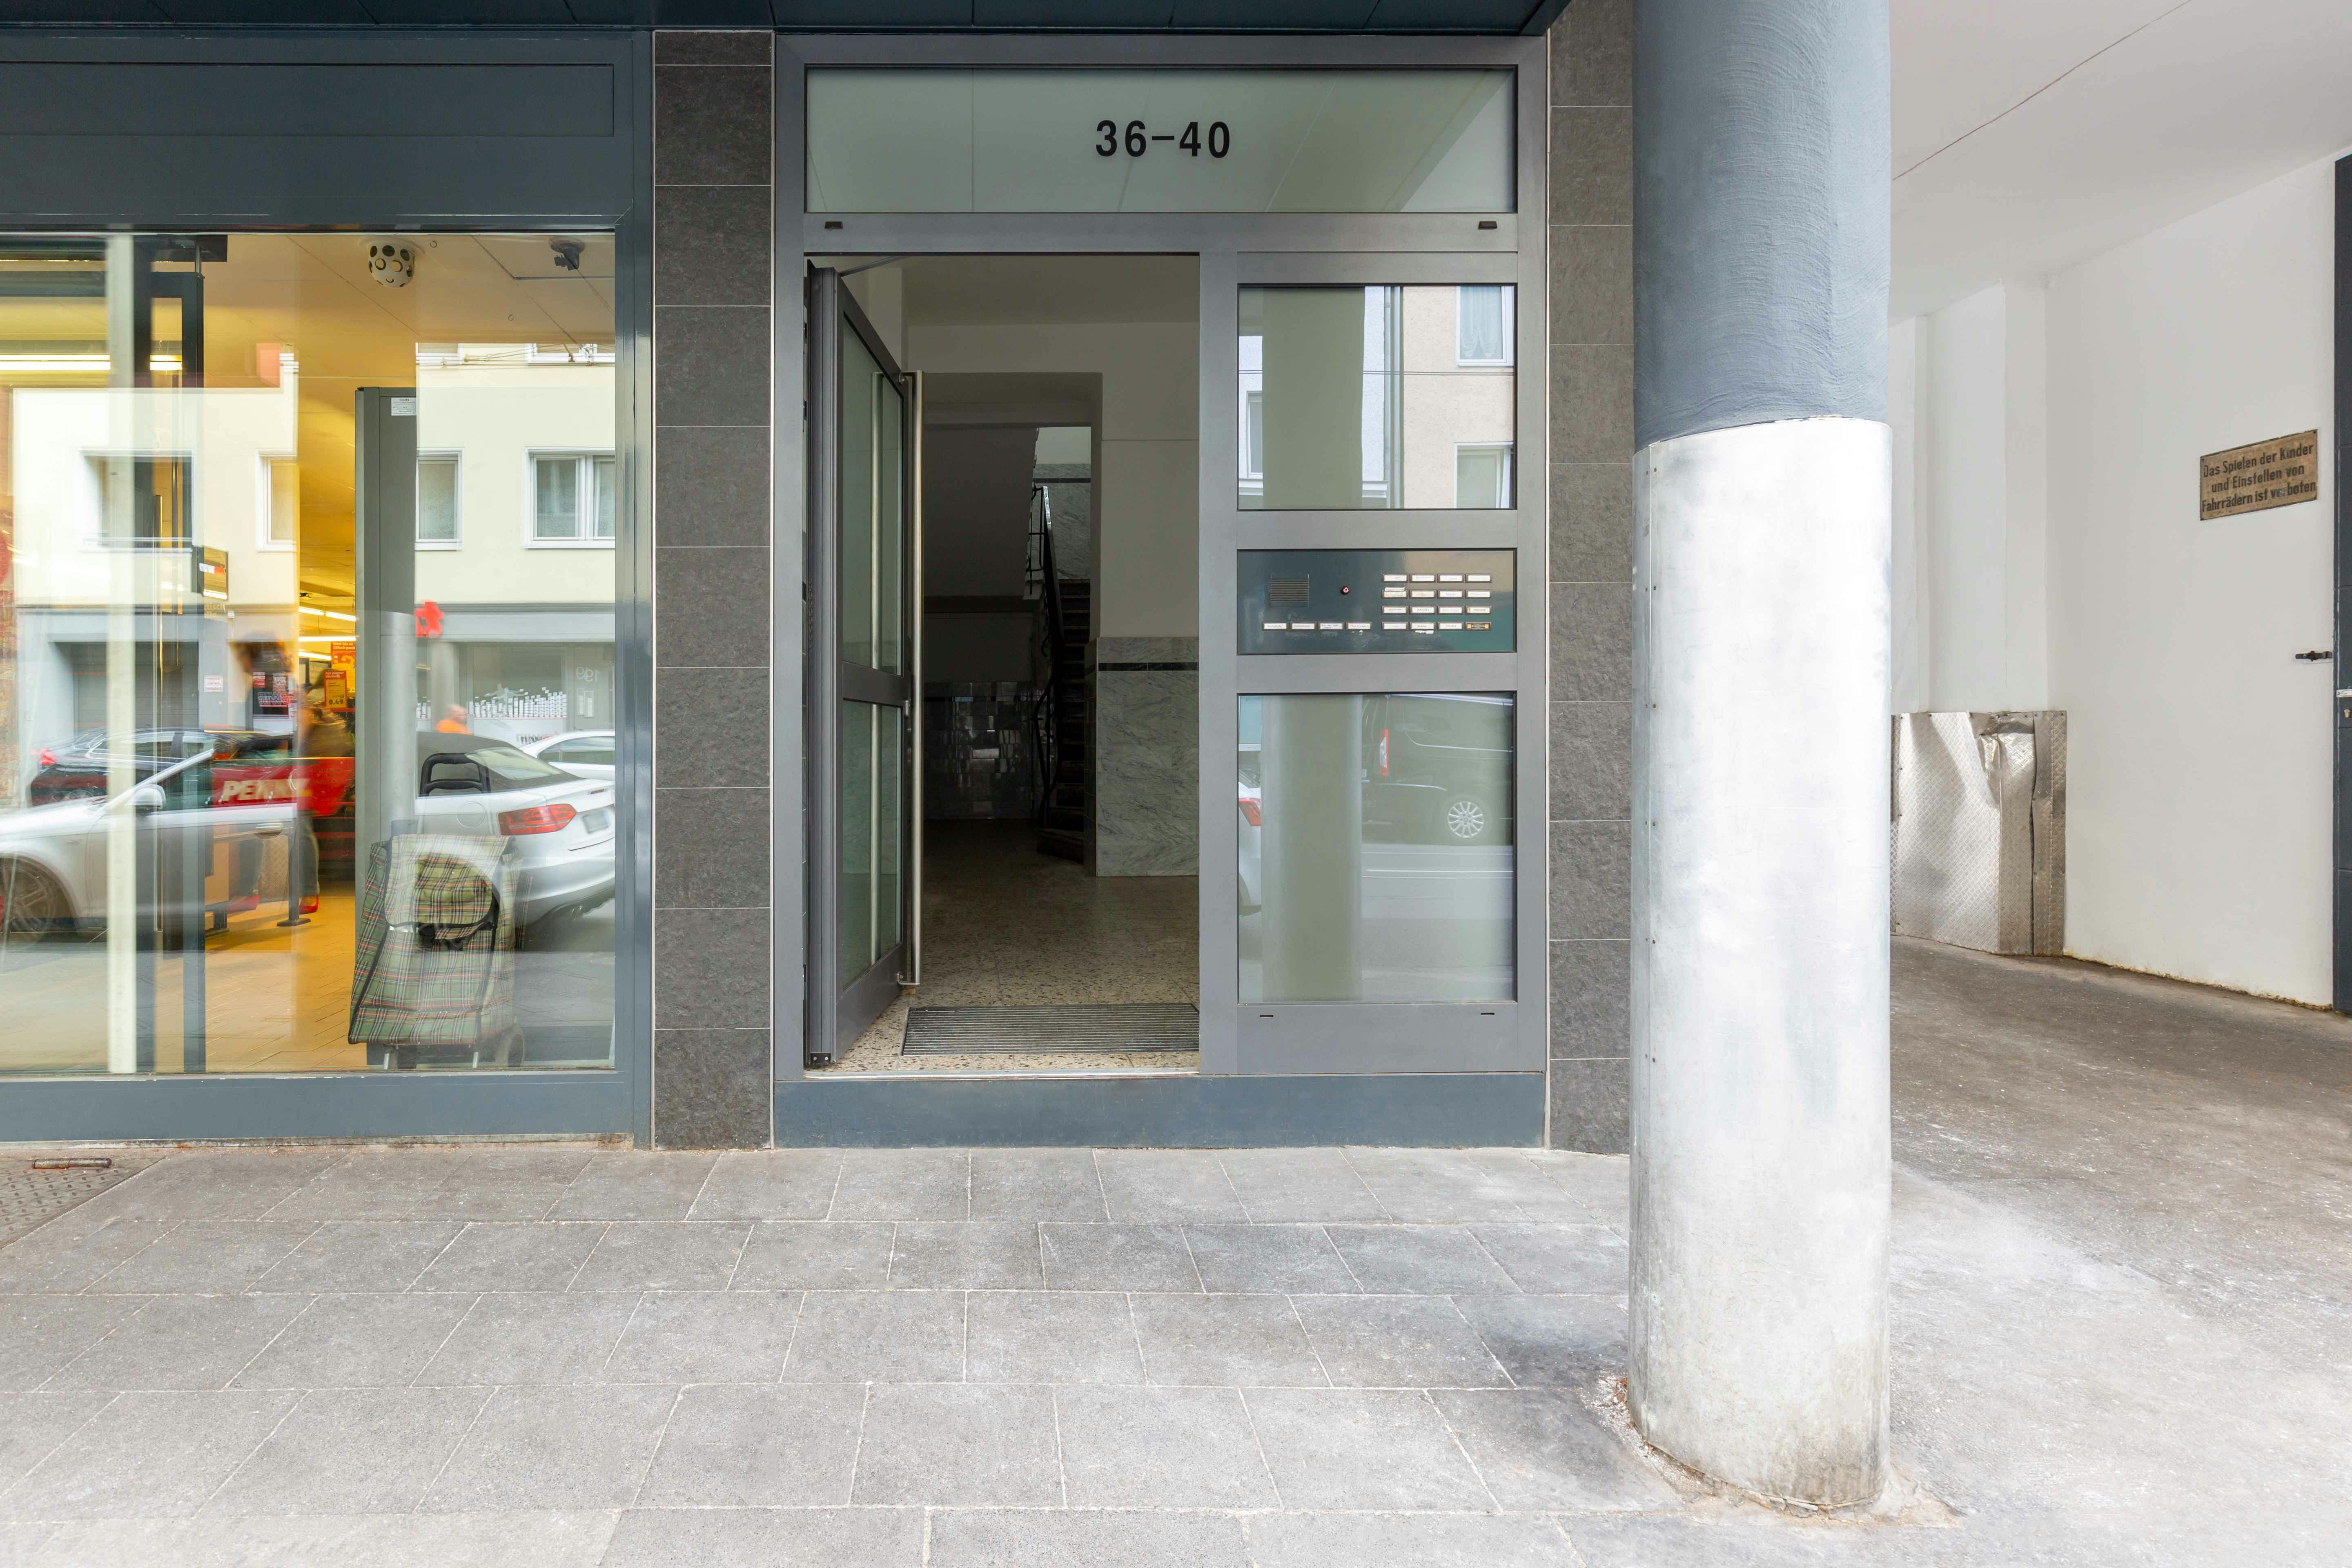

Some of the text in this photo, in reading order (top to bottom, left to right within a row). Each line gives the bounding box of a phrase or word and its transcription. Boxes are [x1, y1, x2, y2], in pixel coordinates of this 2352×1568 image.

[1096, 120, 1230, 158] 36-40
[2203, 443, 2313, 478] Das Spielen der Kinder
[2212, 465, 2304, 493] und Einstellen von
[2202, 493, 2253, 512] Fahrrädern
[2255, 488, 2267, 502] ist
